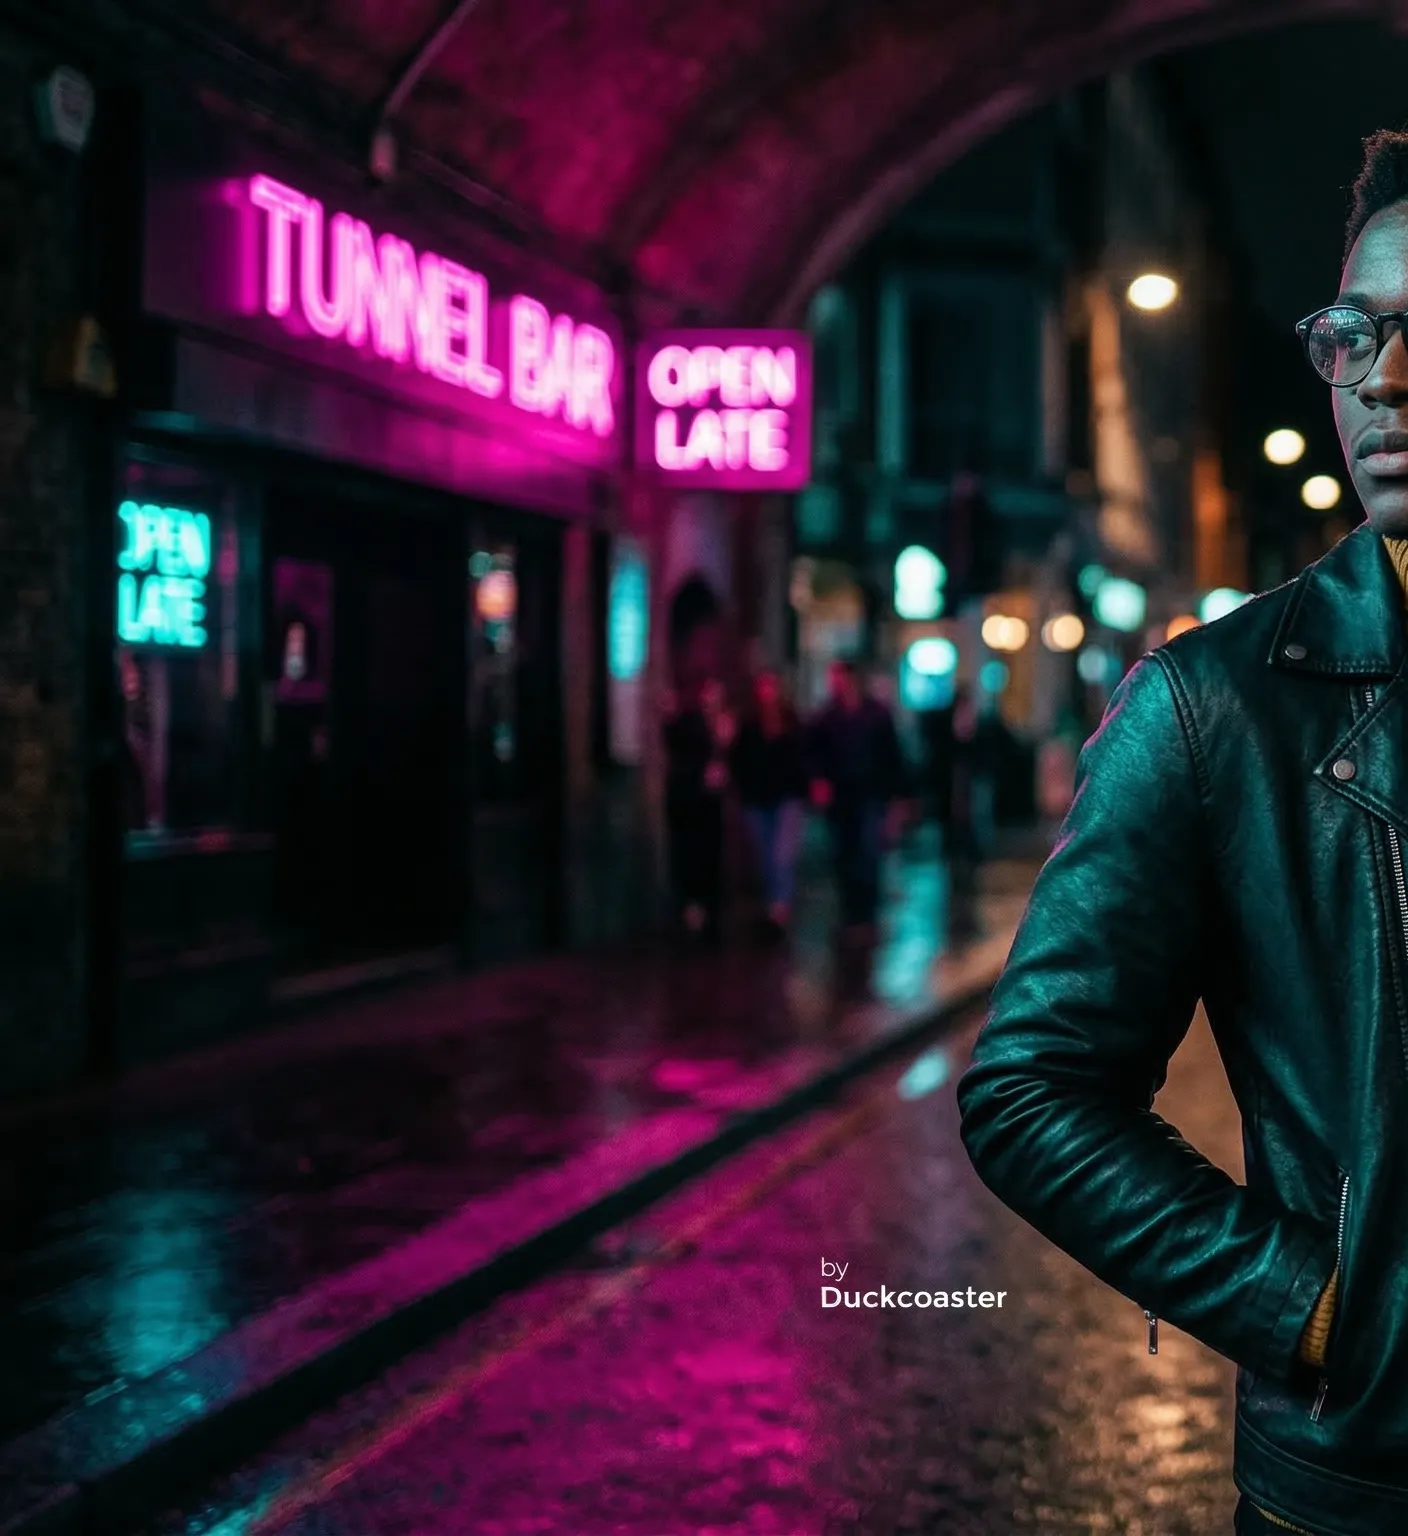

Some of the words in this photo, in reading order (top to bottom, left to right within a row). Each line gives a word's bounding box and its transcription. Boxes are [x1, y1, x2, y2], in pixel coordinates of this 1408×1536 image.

[248, 172, 505, 400] TUNNEL
[509, 293, 616, 438] BAR
[647, 345, 796, 408] OPEN
[655, 408, 789, 472] LATE
[118, 573, 208, 647] LATE
